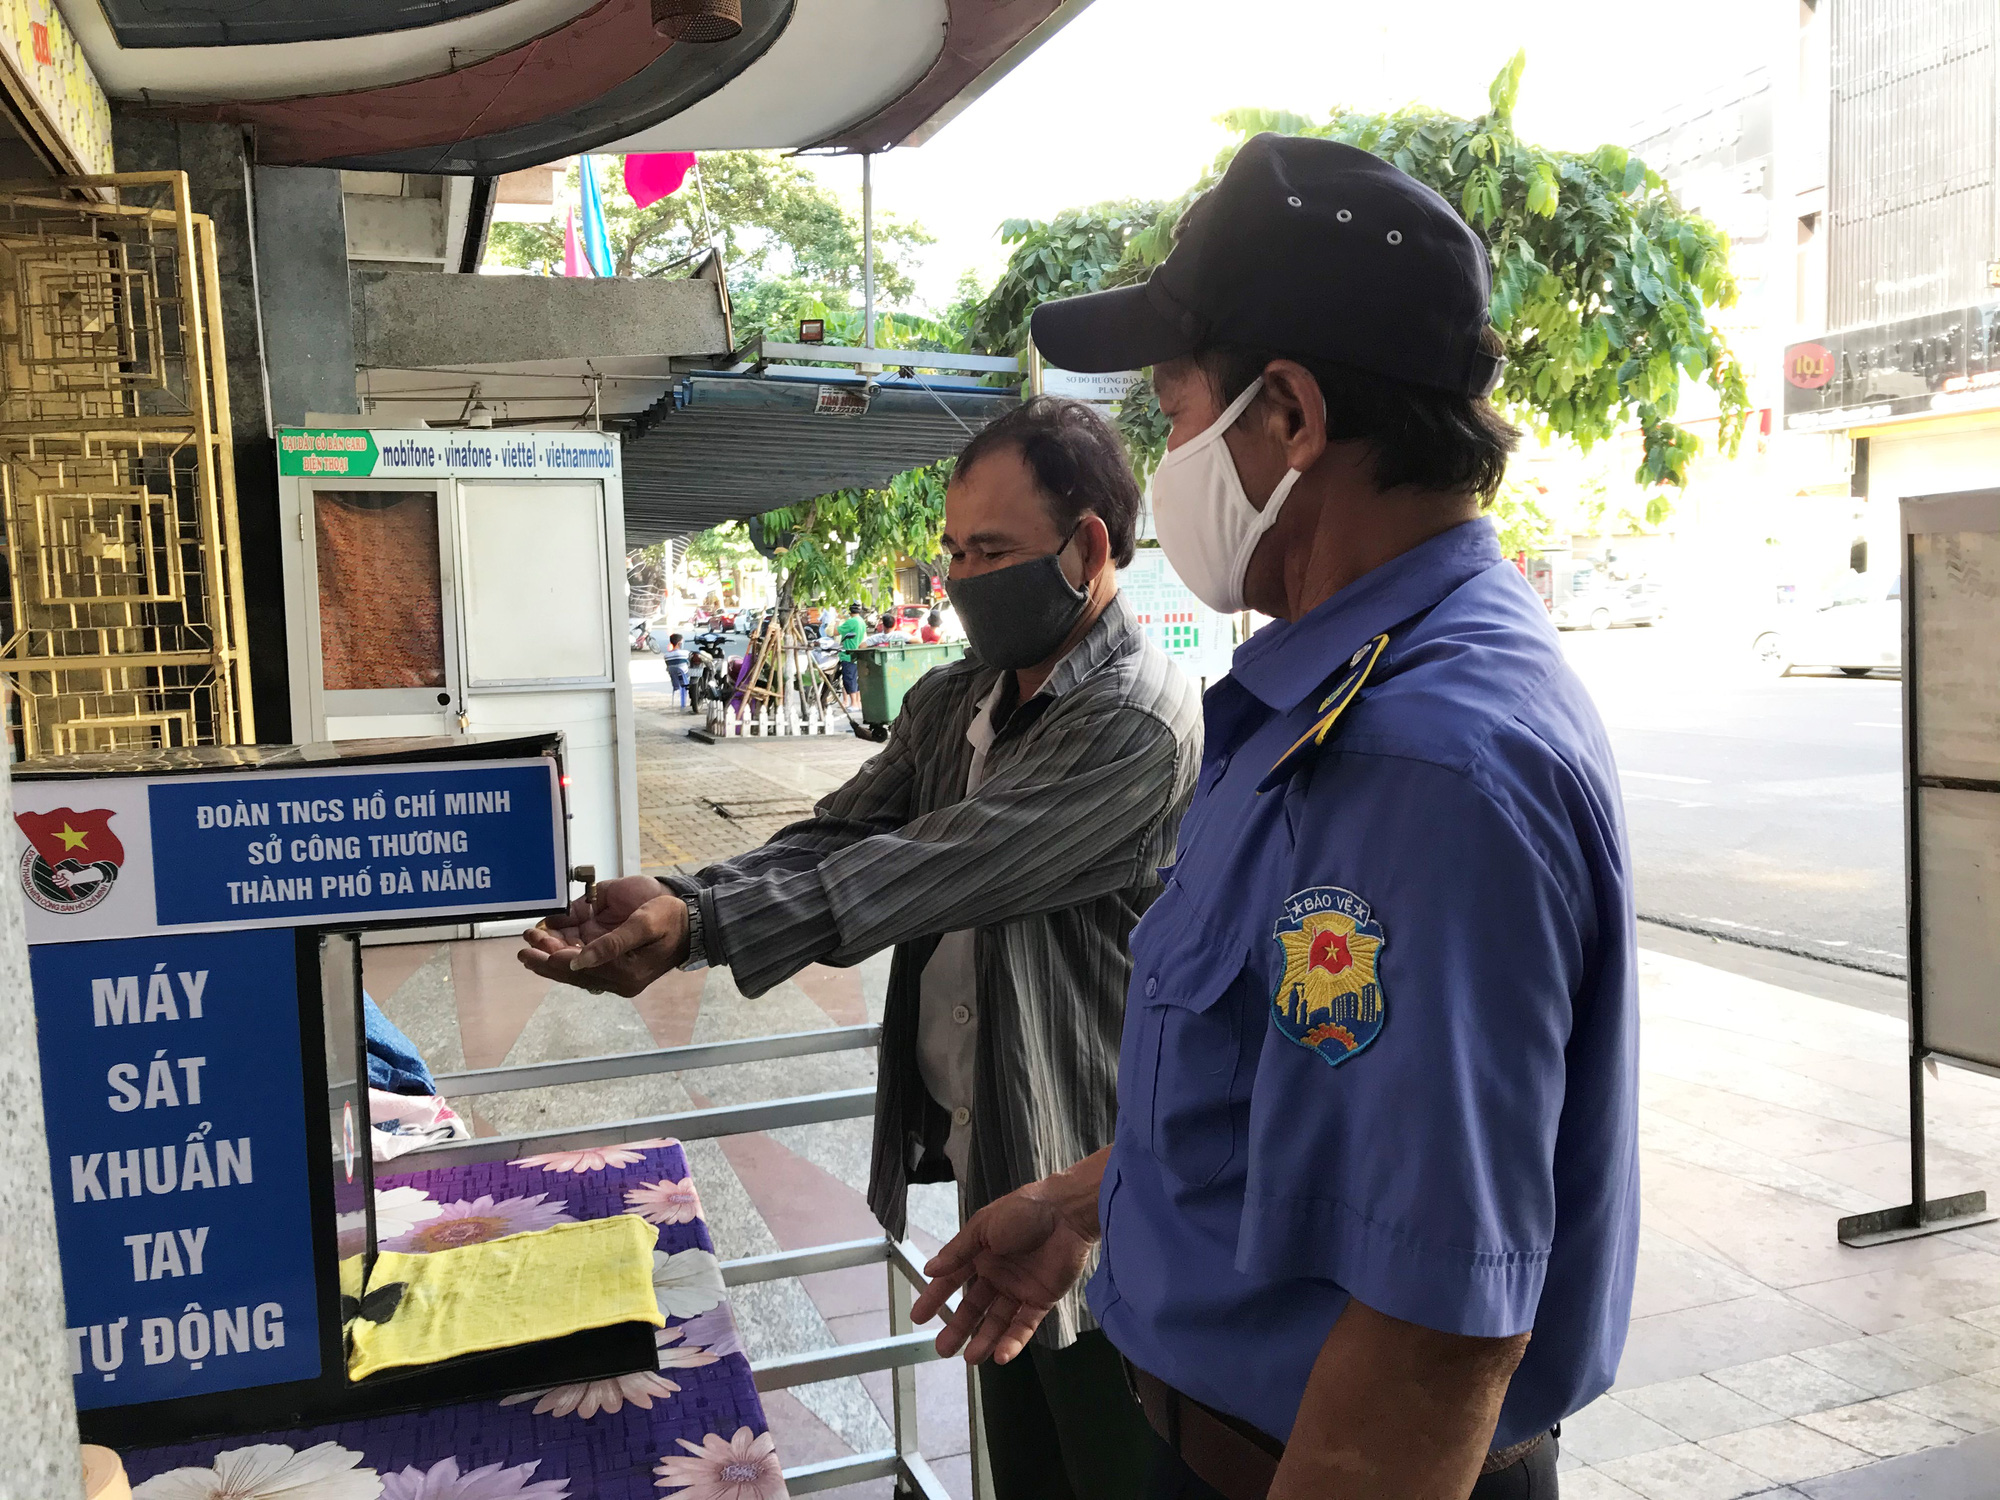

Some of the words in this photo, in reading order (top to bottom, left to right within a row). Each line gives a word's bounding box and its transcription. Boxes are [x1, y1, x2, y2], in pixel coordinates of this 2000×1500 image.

[282, 436, 297, 453] TẠI
[298, 432, 315, 450] ĐÂY
[315, 432, 327, 450] CÓ
[327, 432, 345, 451] BÁN
[345, 437, 367, 451] CARD
[303, 453, 323, 474] ĐIỆN
[323, 456, 349, 474] THOẠI
[382, 439, 435, 467] mobifone
[444, 439, 492, 468] vinafone
[501, 440, 536, 468] viettel
[545, 440, 614, 468] vietnammobi
[197, 799, 270, 829] ĐOÀN
[277, 798, 345, 825] TNCS
[352, 788, 387, 821] HỒ
[394, 789, 437, 819] CHÍ
[444, 790, 511, 816] MINH
[247, 833, 283, 865] SỞ
[290, 832, 361, 863] CÔNG
[367, 829, 469, 858] THƯƠNG
[226, 874, 313, 905] THÀNH
[320, 865, 372, 899] PHỐ
[379, 866, 415, 896] ĐÀ
[421, 860, 492, 893] NẴNG
[1336, 895, 1354, 914] VỆ
[91, 962, 210, 1027] MÁY
[107, 1049, 207, 1113] SÁT
[69, 1120, 254, 1203] KHUẨN
[123, 1226, 210, 1282] TAY
[66, 1316, 129, 1382] TỰ
[140, 1301, 286, 1371] ĐỘNG
